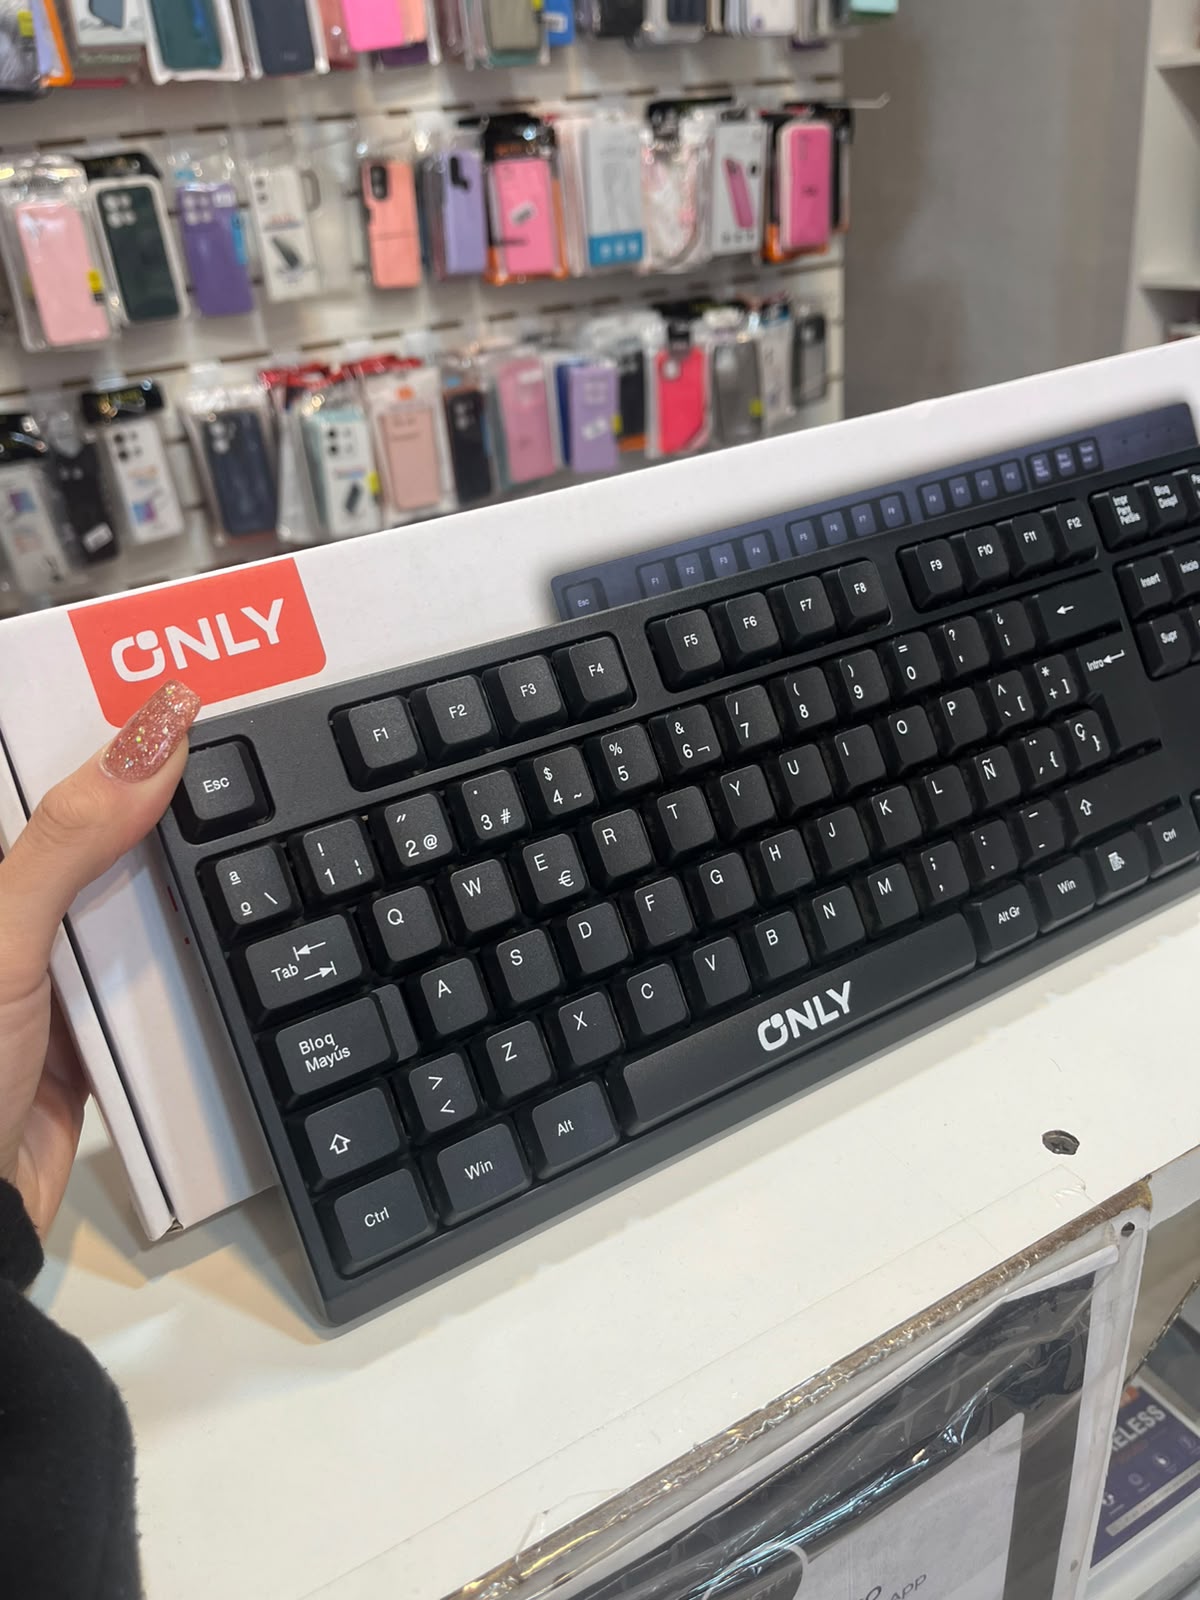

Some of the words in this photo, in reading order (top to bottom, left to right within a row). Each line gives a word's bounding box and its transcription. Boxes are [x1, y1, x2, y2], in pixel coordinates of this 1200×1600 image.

[1066, 516, 1083, 530] F12
[1023, 530, 1037, 543] F11
[977, 543, 994, 557] F10
[685, 566, 695, 574] F2
[929, 559, 943, 572] F9
[651, 577, 659, 585] F1
[853, 582, 867, 595] F8
[799, 598, 812, 612] F7
[742, 615, 758, 629] F6
[111, 598, 284, 682] ONLY
[683, 633, 699, 648] F5
[948, 629, 956, 641] ?
[588, 662, 605, 677] F4
[847, 664, 854, 678] )
[519, 683, 537, 697] F3
[793, 682, 800, 696] (
[853, 684, 864, 699] 9
[448, 703, 468, 719] F2
[799, 703, 809, 719] 8
[946, 700, 956, 716] P
[372, 727, 389, 742] F1
[674, 721, 685, 735] &
[740, 722, 749, 739] 7
[896, 719, 908, 735] O
[1074, 723, 1086, 741] Ç
[608, 742, 623, 756] %
[682, 743, 694, 759] 6
[842, 741, 849, 756] I
[543, 766, 553, 781] $
[617, 765, 629, 782] 5
[787, 759, 800, 775] U
[981, 758, 997, 780] Ñ
[202, 777, 230, 793] Esc
[729, 780, 741, 796] Y
[931, 780, 943, 795] L
[553, 789, 564, 805] 4
[666, 803, 678, 820] T
[879, 799, 893, 816] K
[480, 814, 493, 831] 3
[828, 822, 836, 838] J
[601, 827, 617, 845] R
[405, 839, 420, 858] 2
[768, 844, 782, 862] H
[533, 853, 549, 872] E
[324, 868, 336, 885] 1
[558, 869, 574, 887] €
[710, 869, 724, 885] G
[462, 877, 481, 897] W
[877, 877, 892, 896] M
[1057, 880, 1077, 894] Win
[644, 894, 655, 912] F
[822, 902, 836, 919] N
[387, 908, 405, 926] Q
[997, 910, 1011, 924] Alt
[578, 921, 592, 939] D
[765, 928, 779, 946] B
[510, 948, 523, 966] S
[704, 954, 716, 971] V
[270, 961, 301, 982] Tab
[438, 979, 452, 999] A
[641, 982, 654, 999] C
[573, 1011, 588, 1031] X
[757, 980, 851, 1052] ONLY
[298, 1032, 337, 1061] Bloq
[501, 1041, 518, 1062] Z
[304, 1042, 352, 1074] Mayús
[558, 1119, 574, 1137] Alt
[464, 1160, 494, 1180] Win
[364, 1206, 390, 1227] Ctrl
